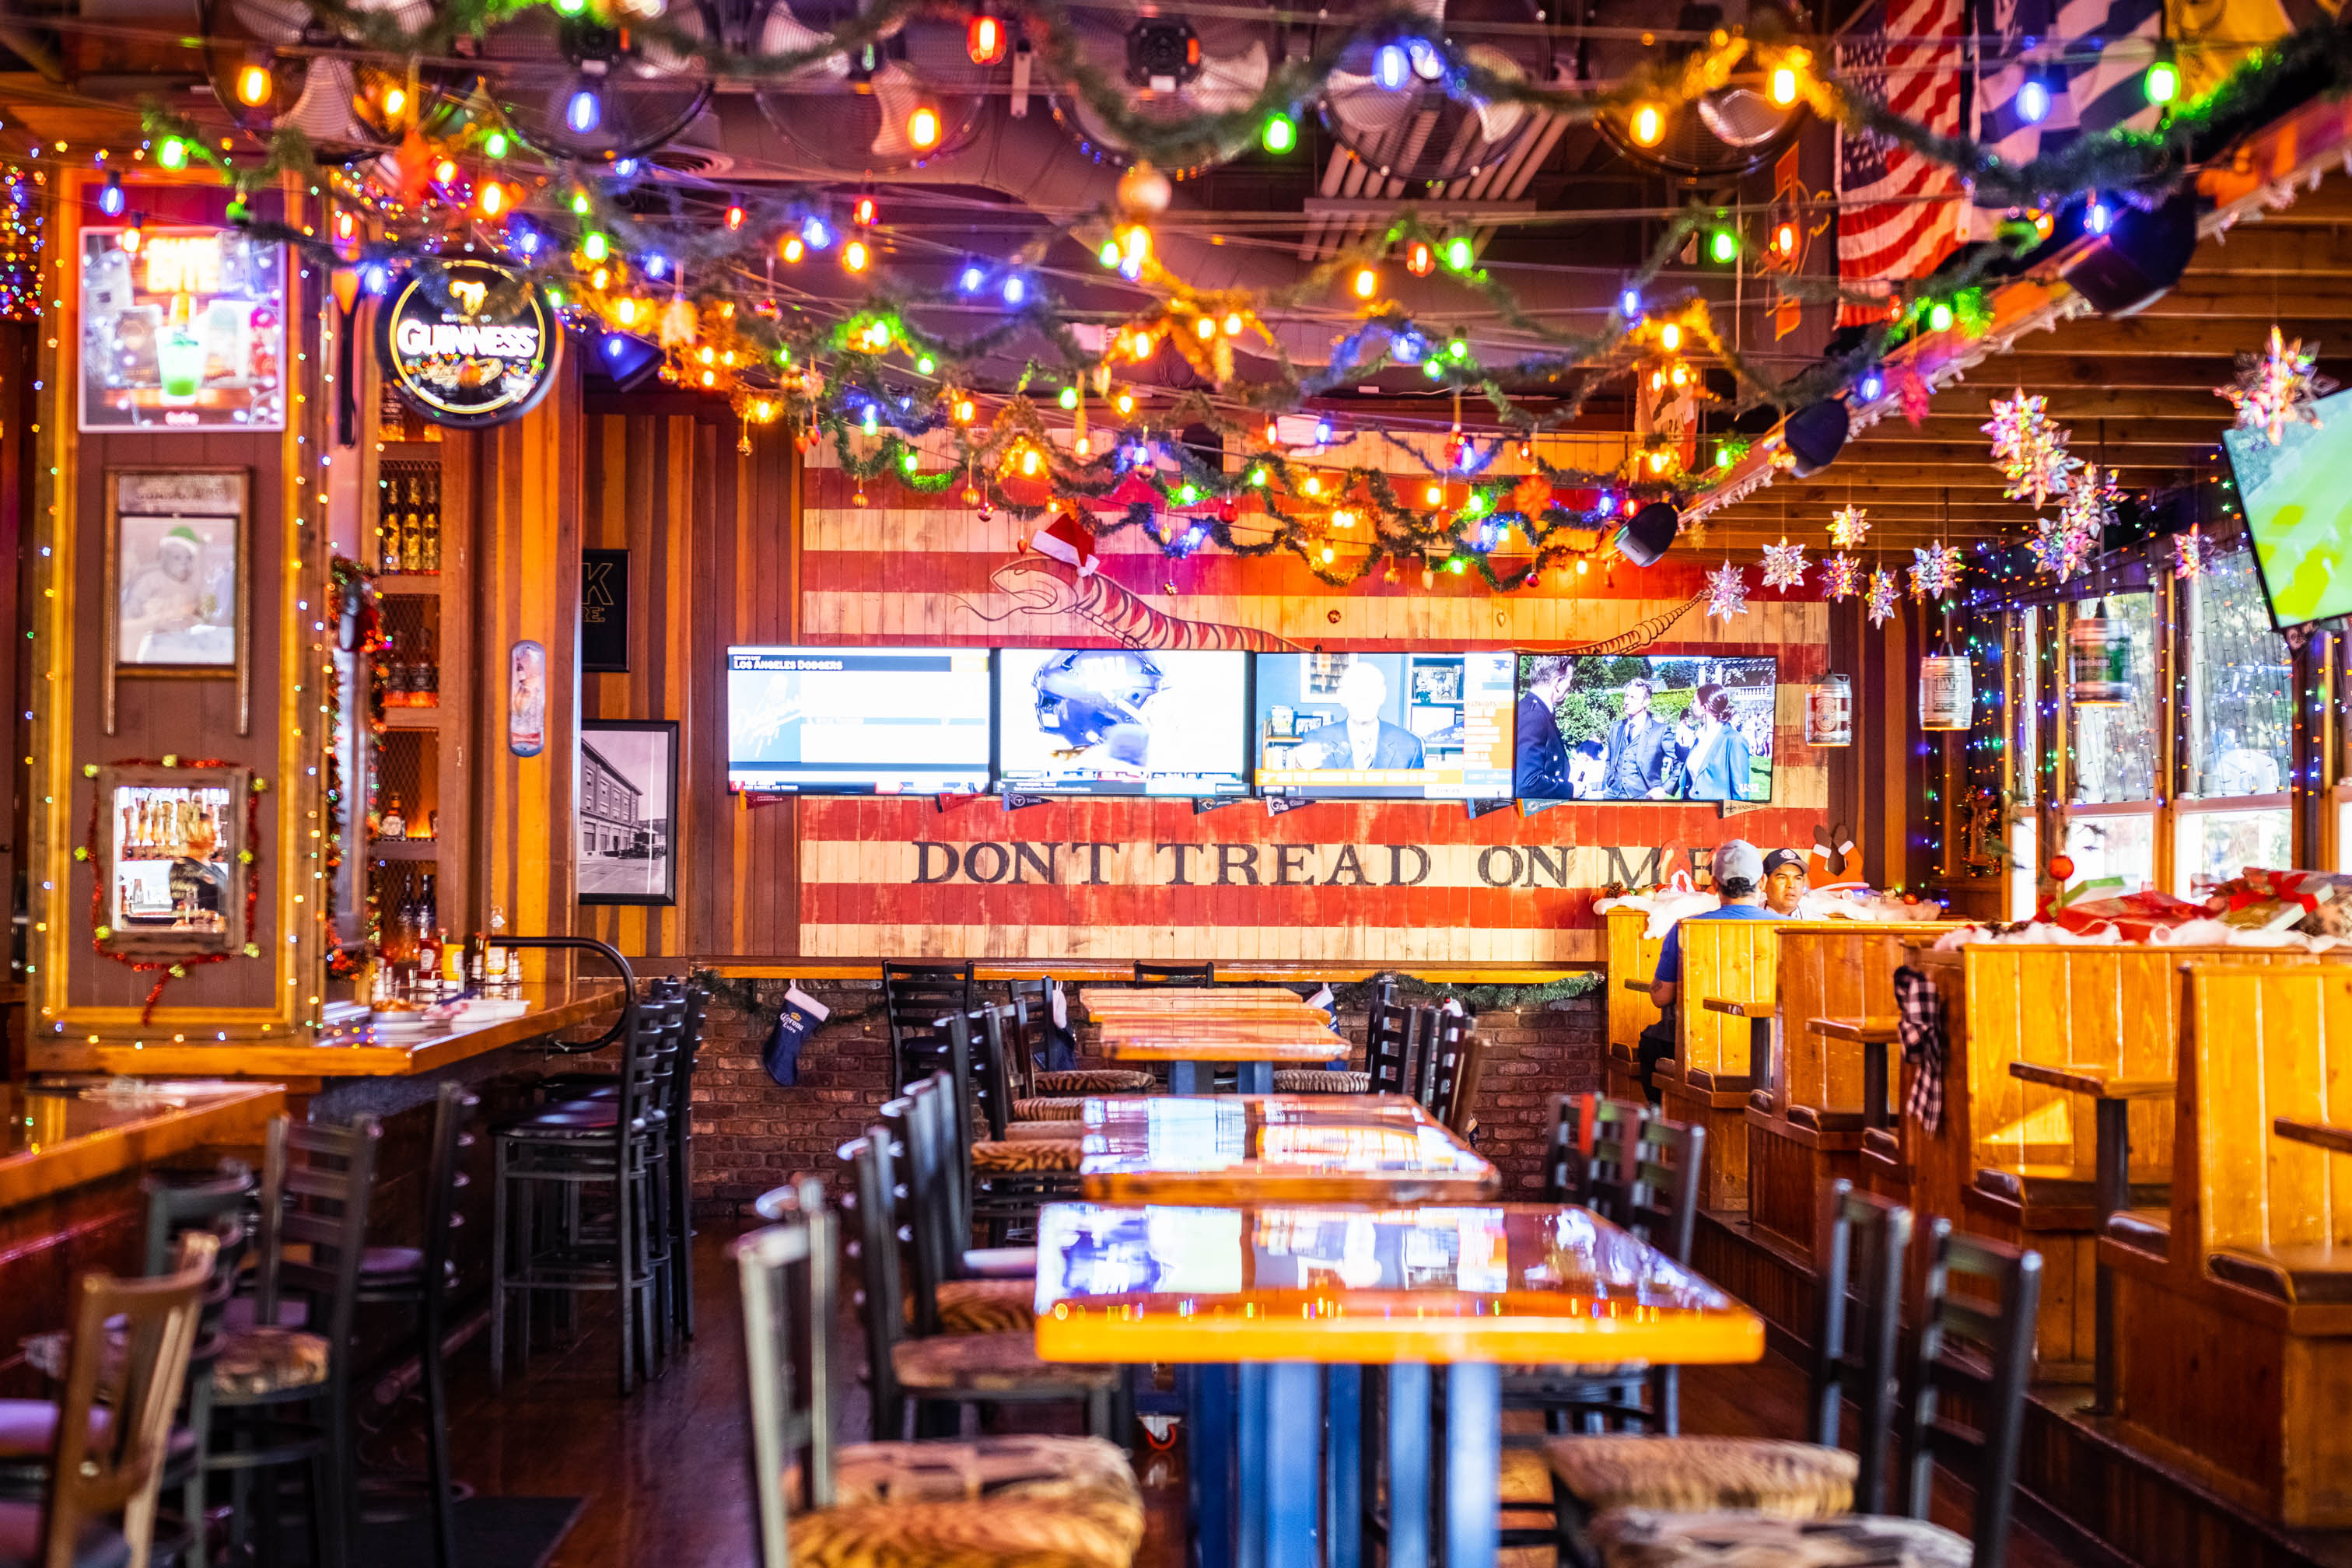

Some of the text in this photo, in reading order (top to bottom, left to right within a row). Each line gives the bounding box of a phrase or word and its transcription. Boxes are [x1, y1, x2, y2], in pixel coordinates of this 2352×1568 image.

[397, 319, 539, 358] GUINNESS
[1156, 842, 1432, 886] TREAD
[1478, 845, 1576, 888] ON
[780, 1013, 804, 1031] Corona
